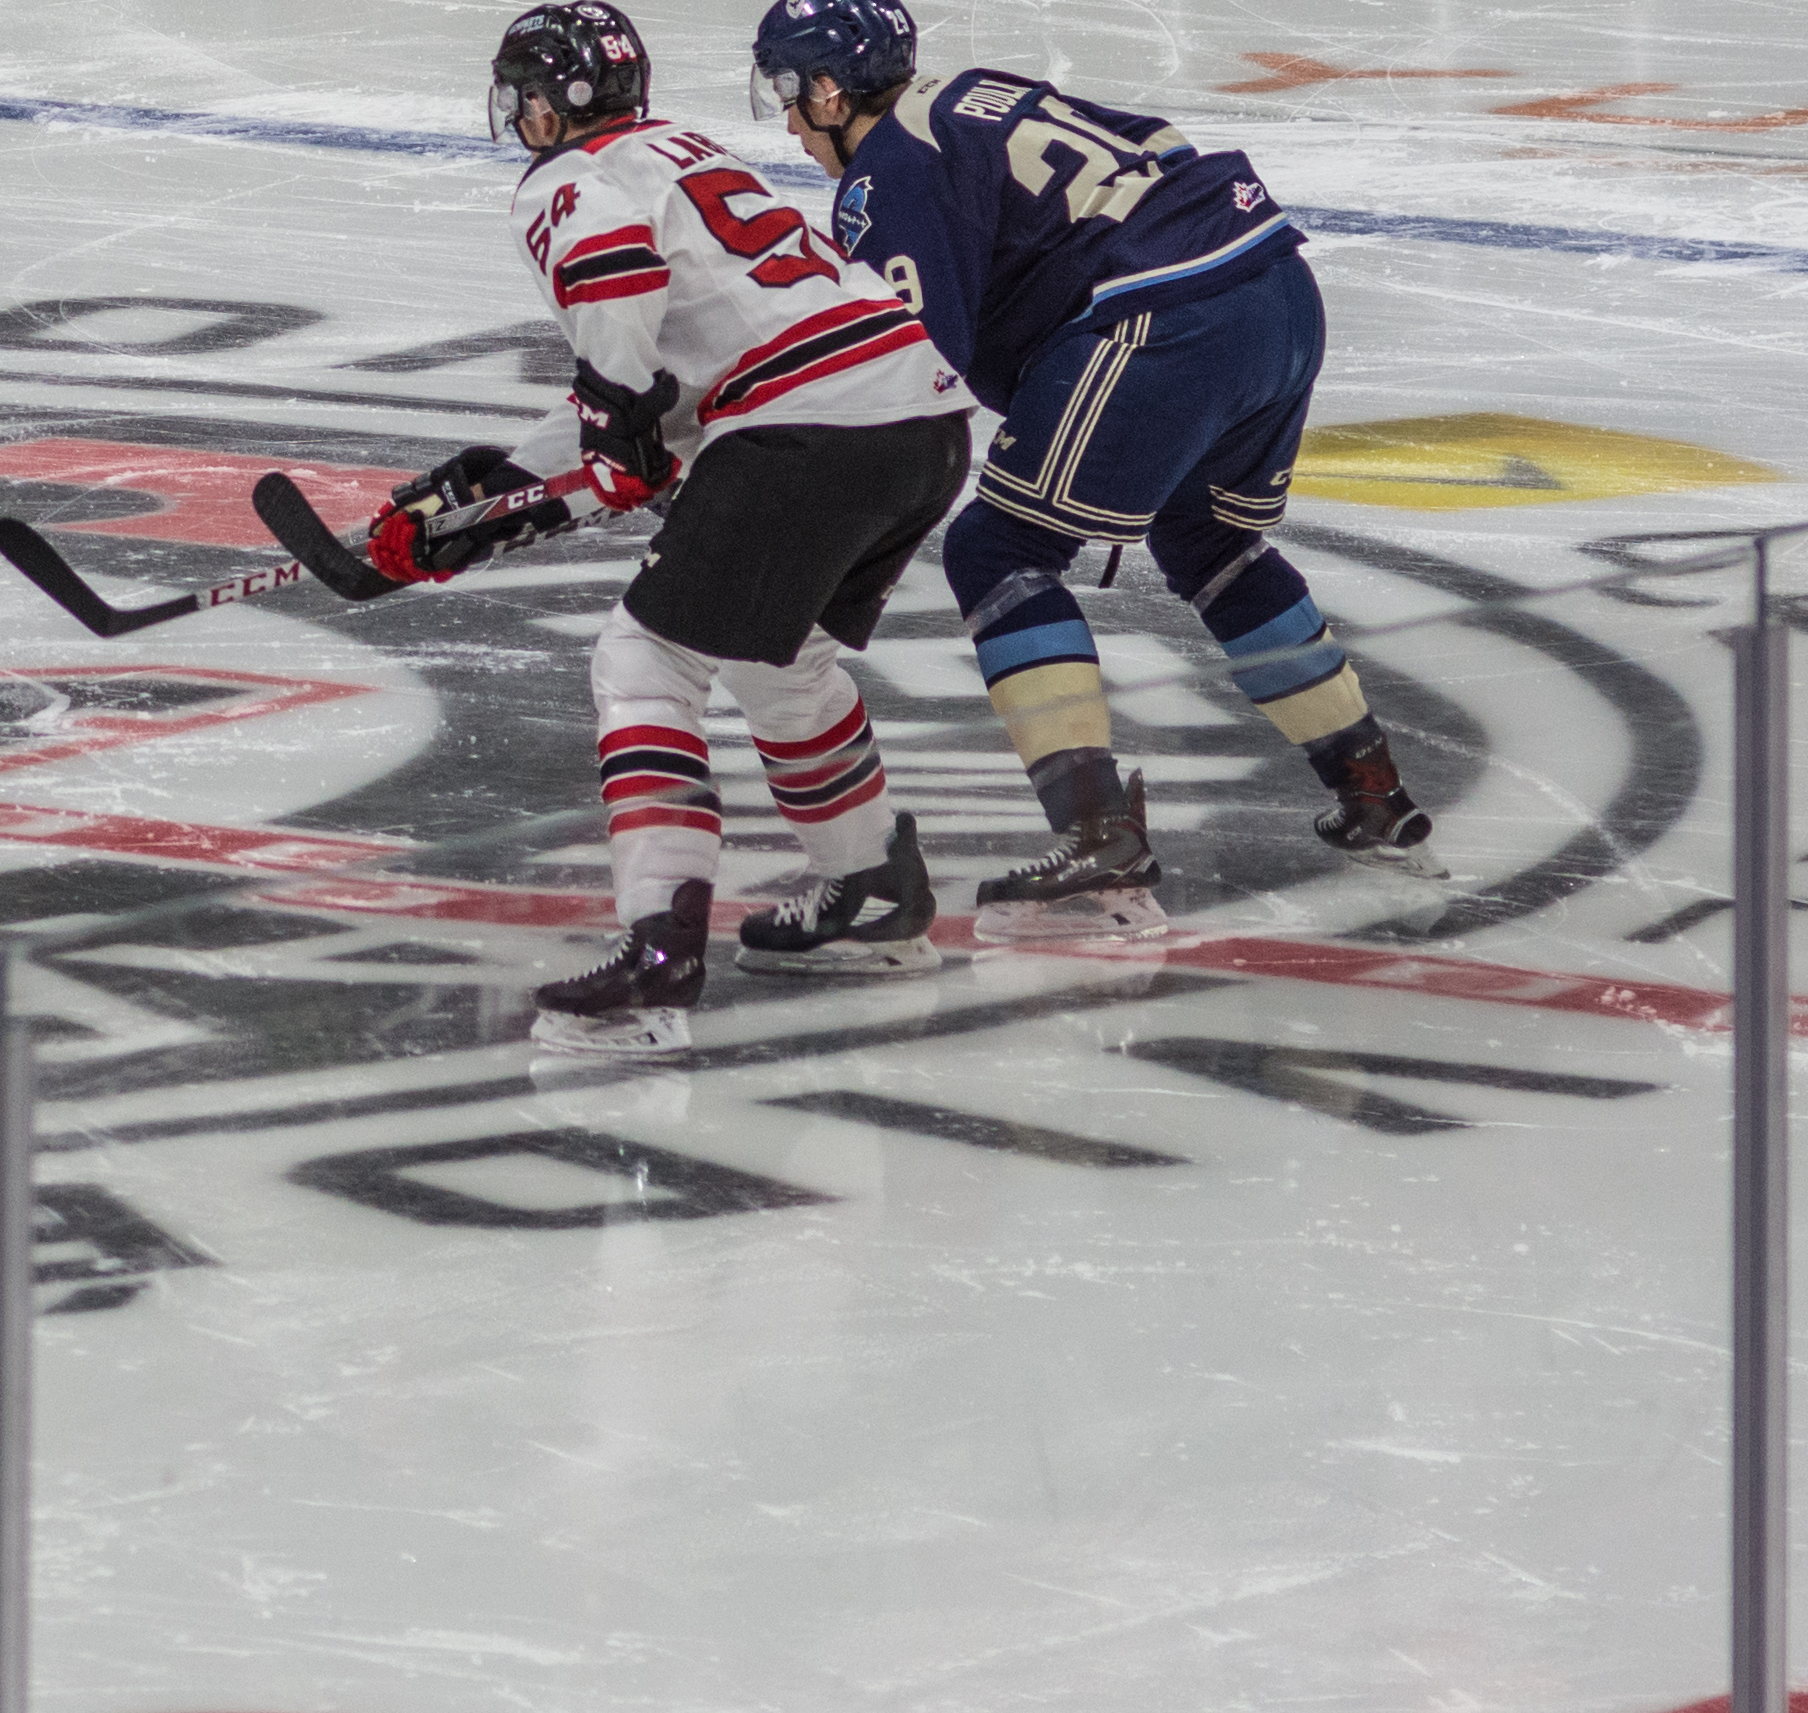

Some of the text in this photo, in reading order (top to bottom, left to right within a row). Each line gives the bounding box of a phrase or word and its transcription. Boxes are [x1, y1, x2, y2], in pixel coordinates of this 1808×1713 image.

[599, 33, 637, 63] 54
[884, 254, 925, 316] 9
[210, 562, 301, 607] CCM
